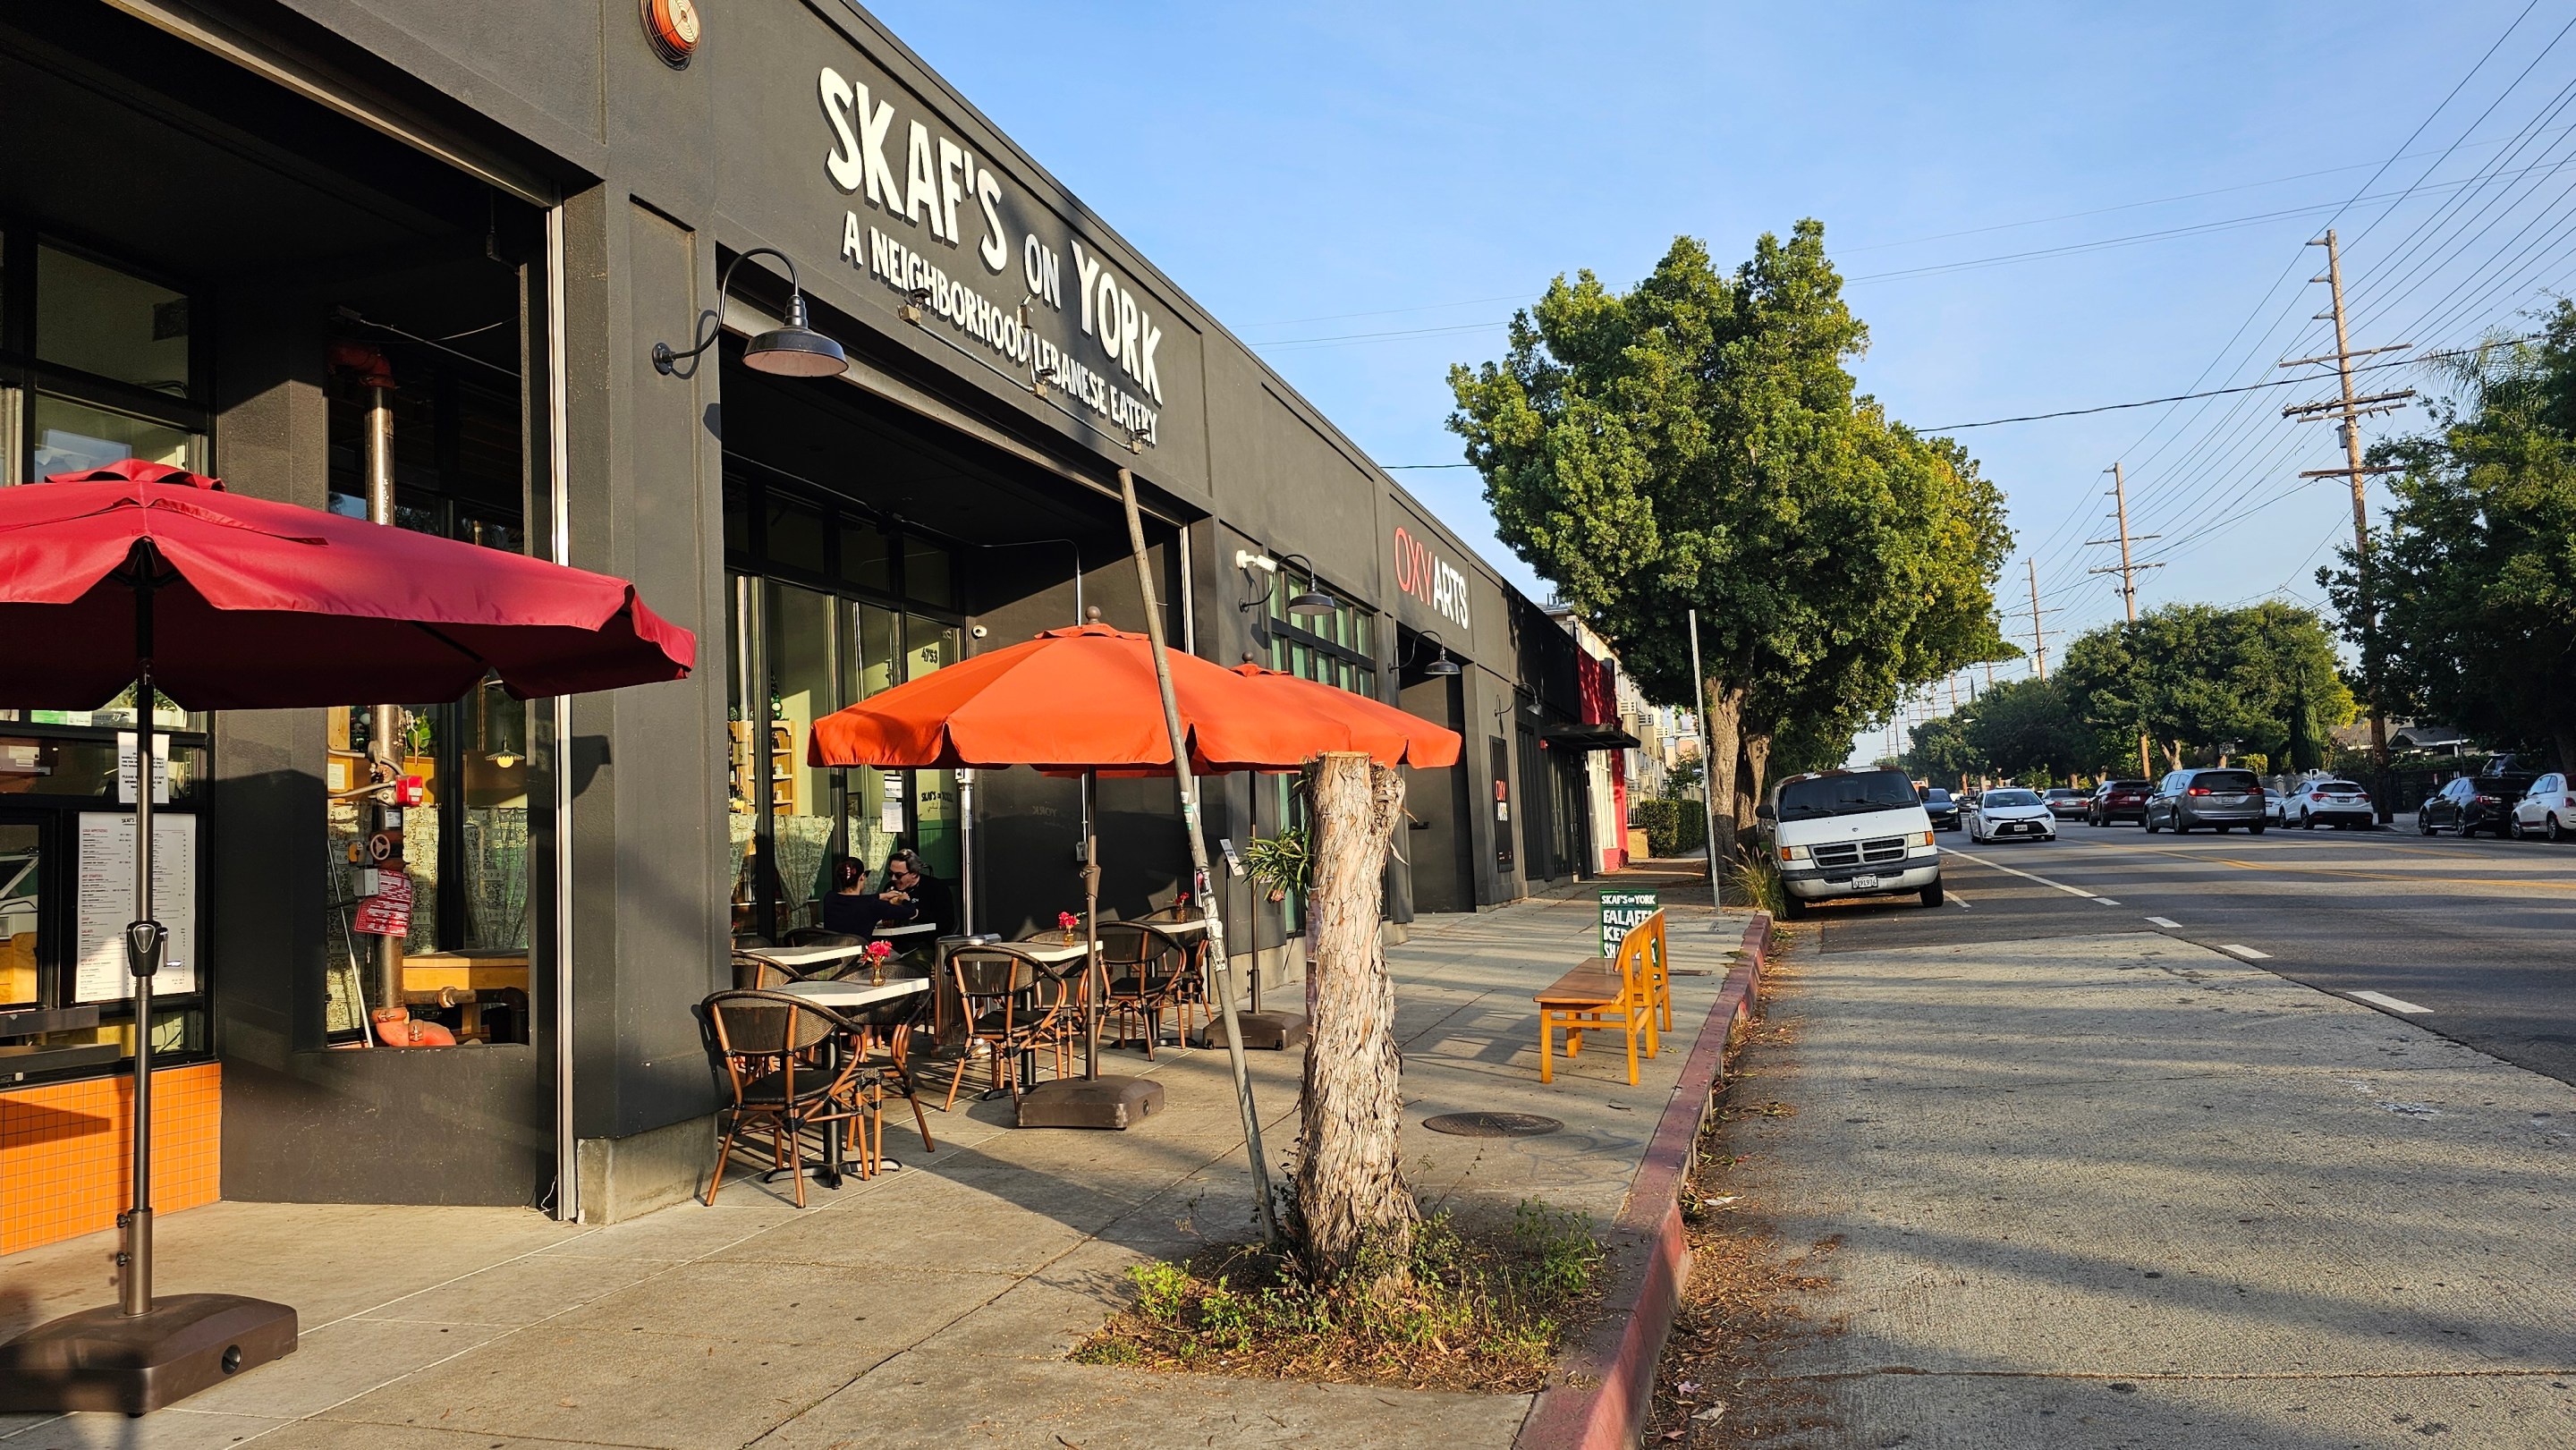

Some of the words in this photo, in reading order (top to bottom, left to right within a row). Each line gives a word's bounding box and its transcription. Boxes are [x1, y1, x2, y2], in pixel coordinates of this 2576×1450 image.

[819, 67, 1007, 271] SKAF'S
[1023, 233, 1062, 310] ON
[1071, 239, 1163, 406] YORK
[843, 210, 864, 267] A
[869, 226, 1030, 362] NEIGHBORHOOD
[1033, 333, 1107, 415] LEBANESE
[1110, 385, 1158, 446] EATERY
[1394, 527, 1432, 606] OXY
[1433, 555, 1469, 630] ARTS
[921, 648, 937, 664] 4753
[1496, 780, 1506, 801] OXY
[1601, 895, 1628, 904] SKAF'S
[1634, 895, 1656, 904] YORK
